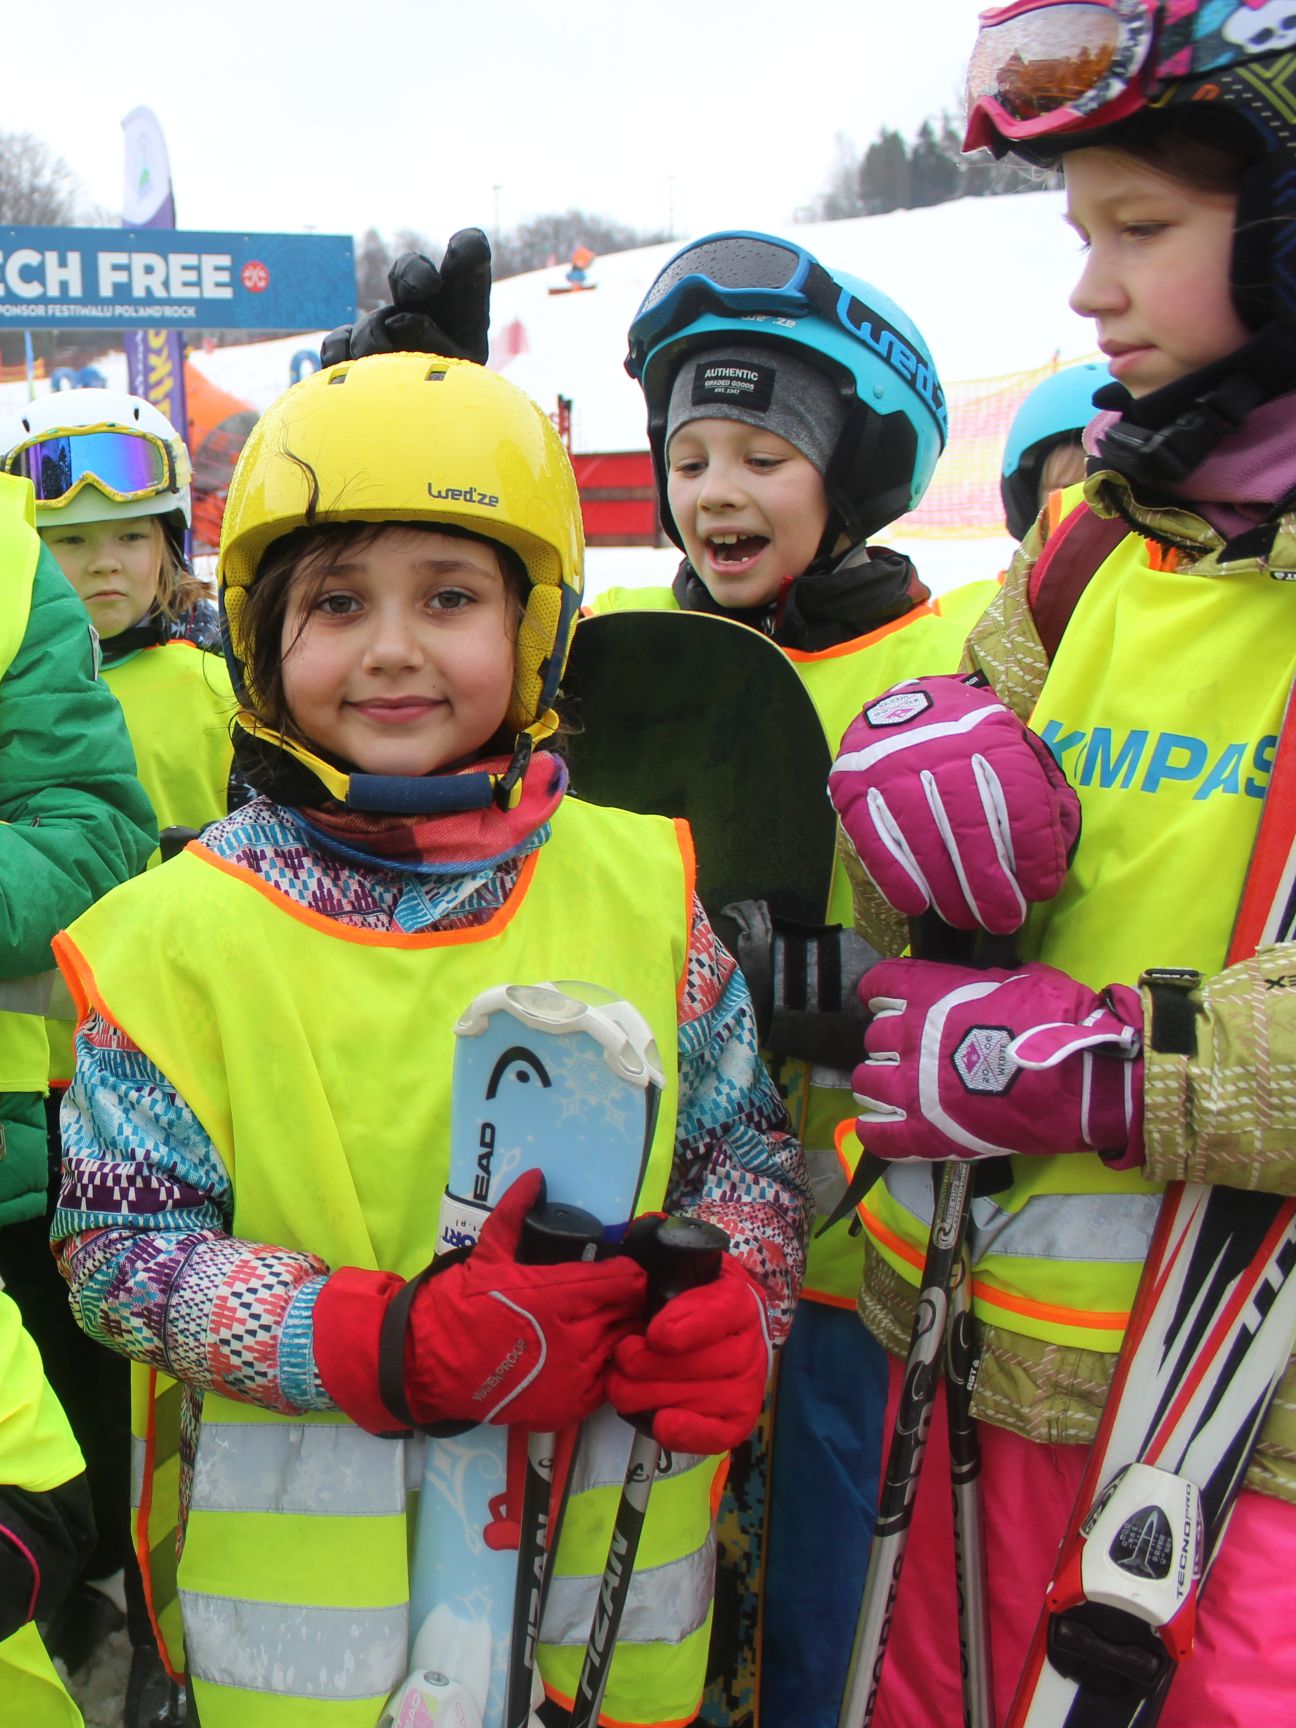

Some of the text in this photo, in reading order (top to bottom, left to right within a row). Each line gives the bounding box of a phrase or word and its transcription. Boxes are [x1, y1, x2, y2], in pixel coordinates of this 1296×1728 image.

[97, 252, 233, 299] FREE
[48, 304, 113, 317] FESTIWALU
[704, 367, 759, 381] AUTHENTIC
[731, 381, 755, 390] GOODS
[1039, 719, 1279, 800] KMPAS
[473, 1122, 496, 1202] EAD
[442, 1226, 478, 1249] ORT
